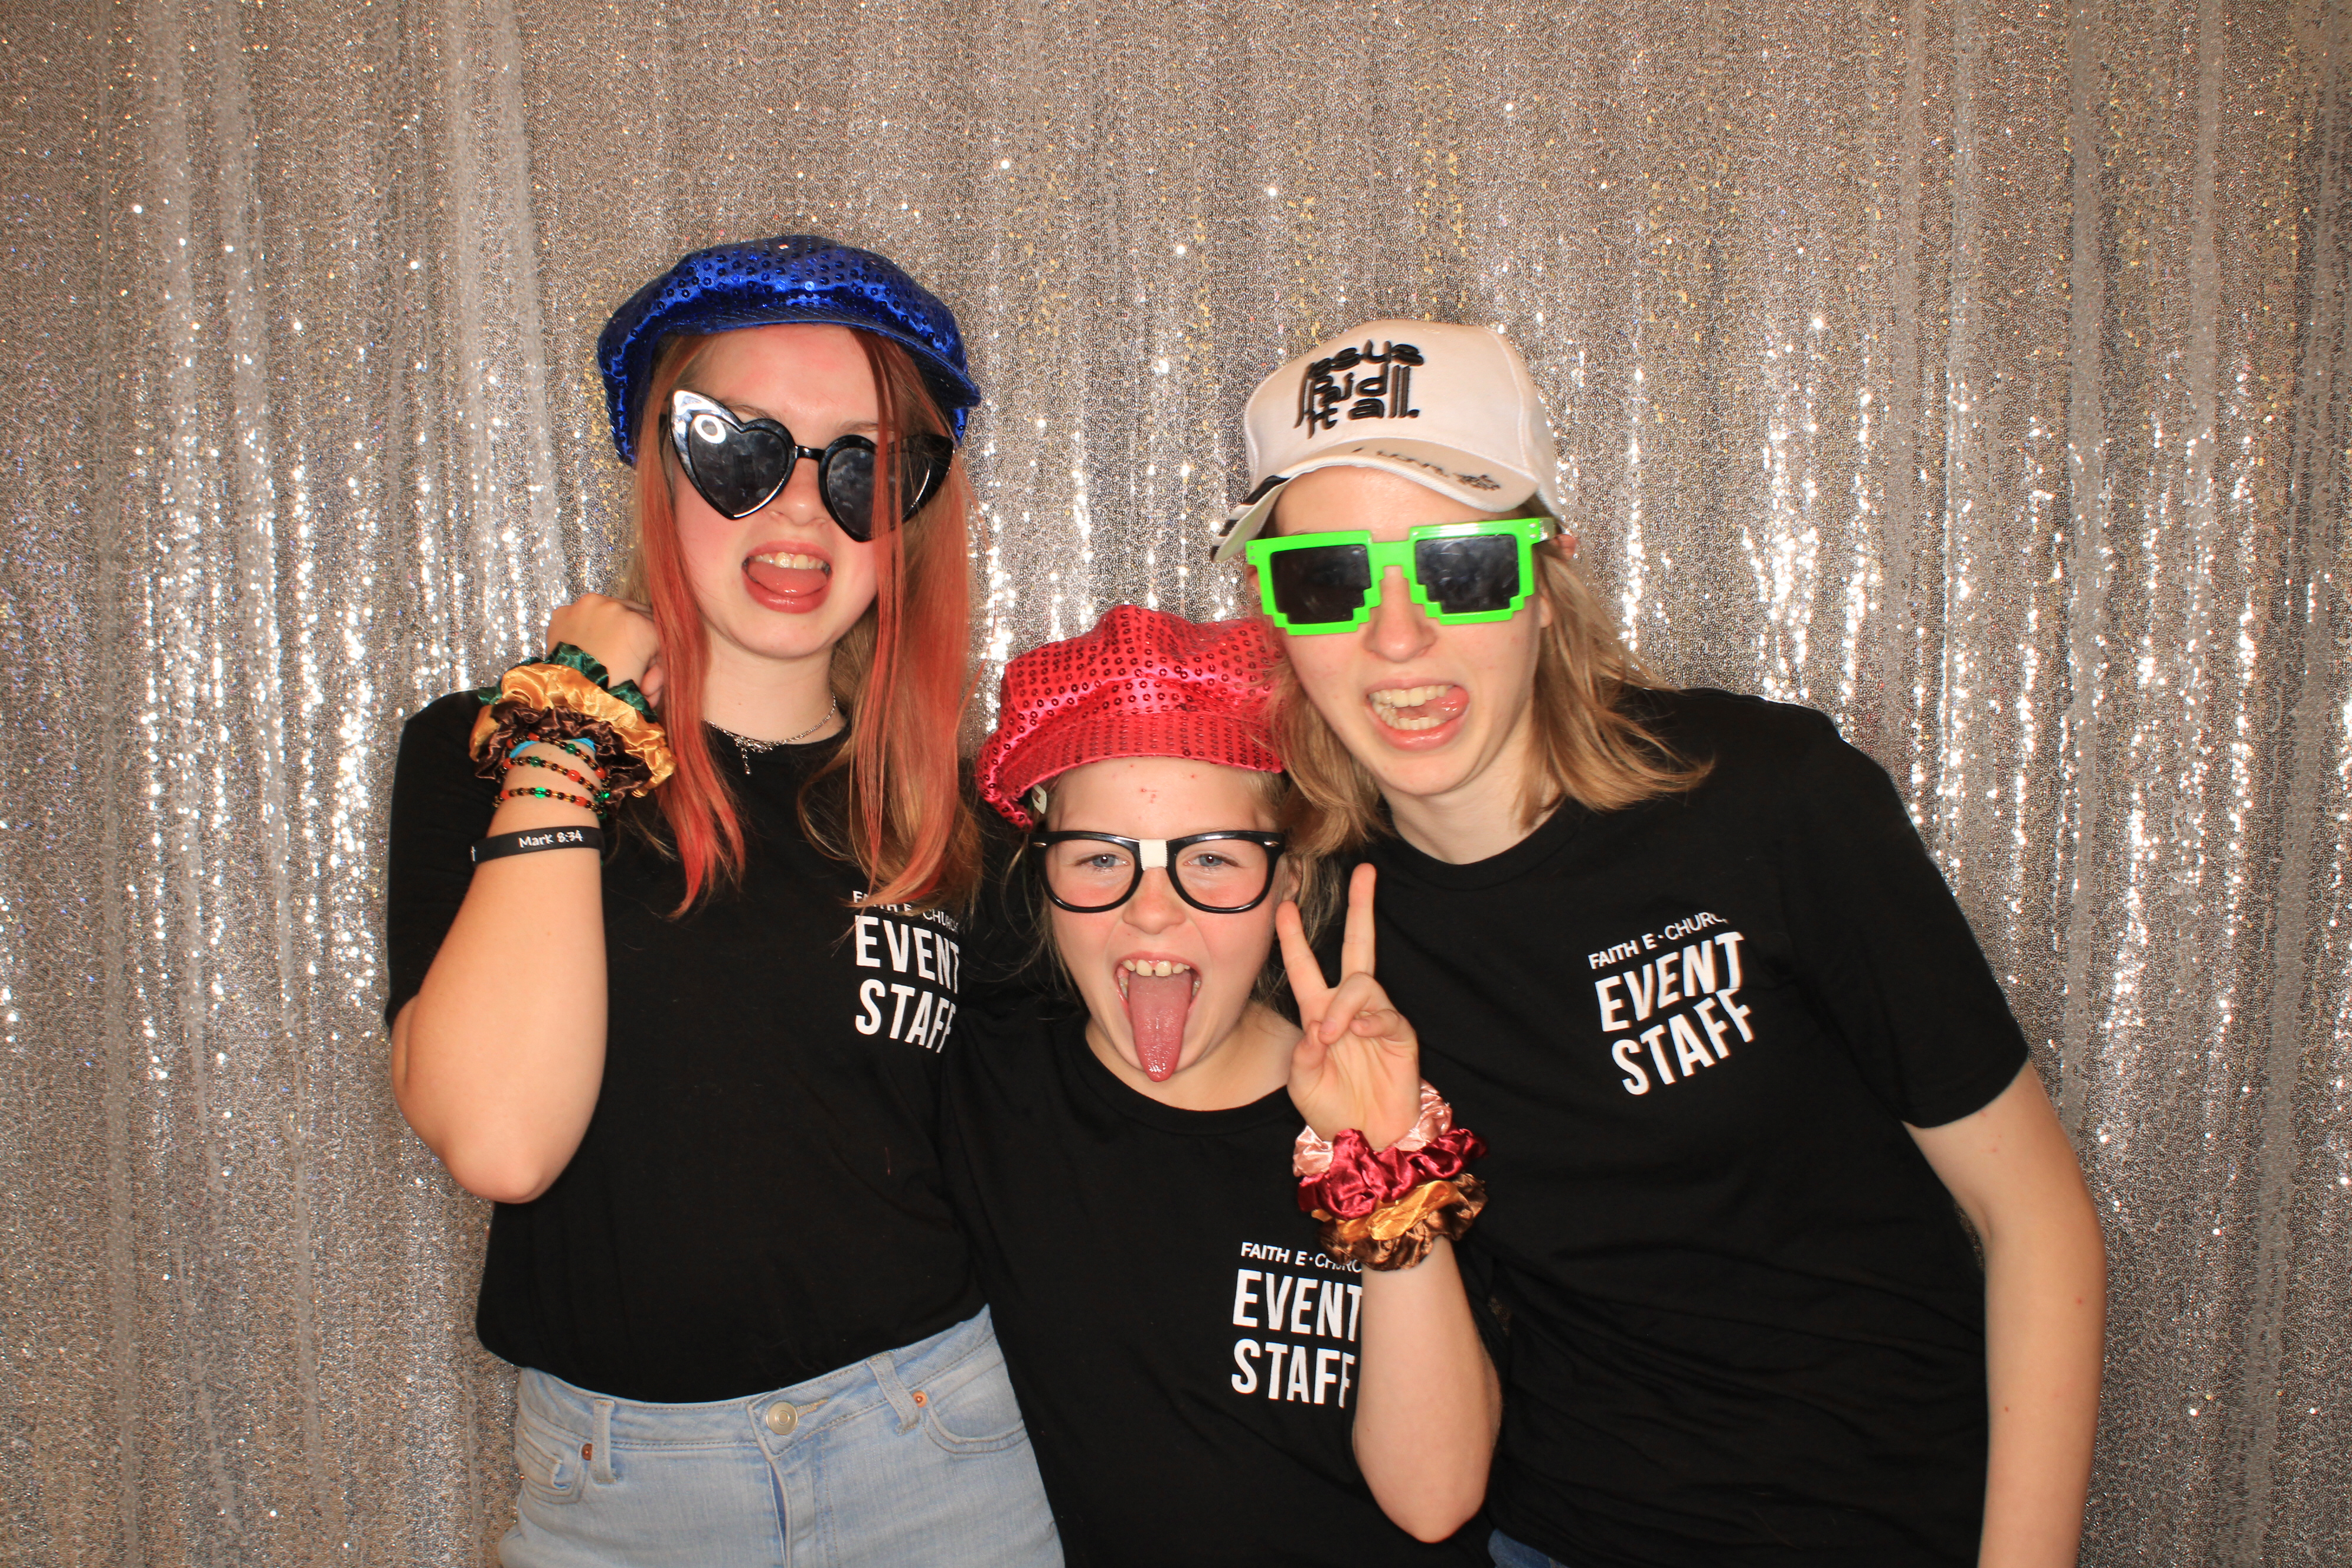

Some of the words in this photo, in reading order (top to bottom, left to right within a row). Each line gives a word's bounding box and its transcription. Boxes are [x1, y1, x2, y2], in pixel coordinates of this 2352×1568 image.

[518, 833, 554, 848] Mark
[556, 829, 584, 843] 8:34
[855, 915, 960, 994] EVENT
[1587, 940, 1641, 969] FAITH
[1595, 931, 1745, 1032] EVENT
[855, 979, 956, 1053] STAFF
[1611, 988, 1755, 1096] STAFF
[1240, 1242, 1291, 1263] FAITH
[1233, 1269, 1363, 1342] EVENT
[1231, 1338, 1355, 1409] STAFF
